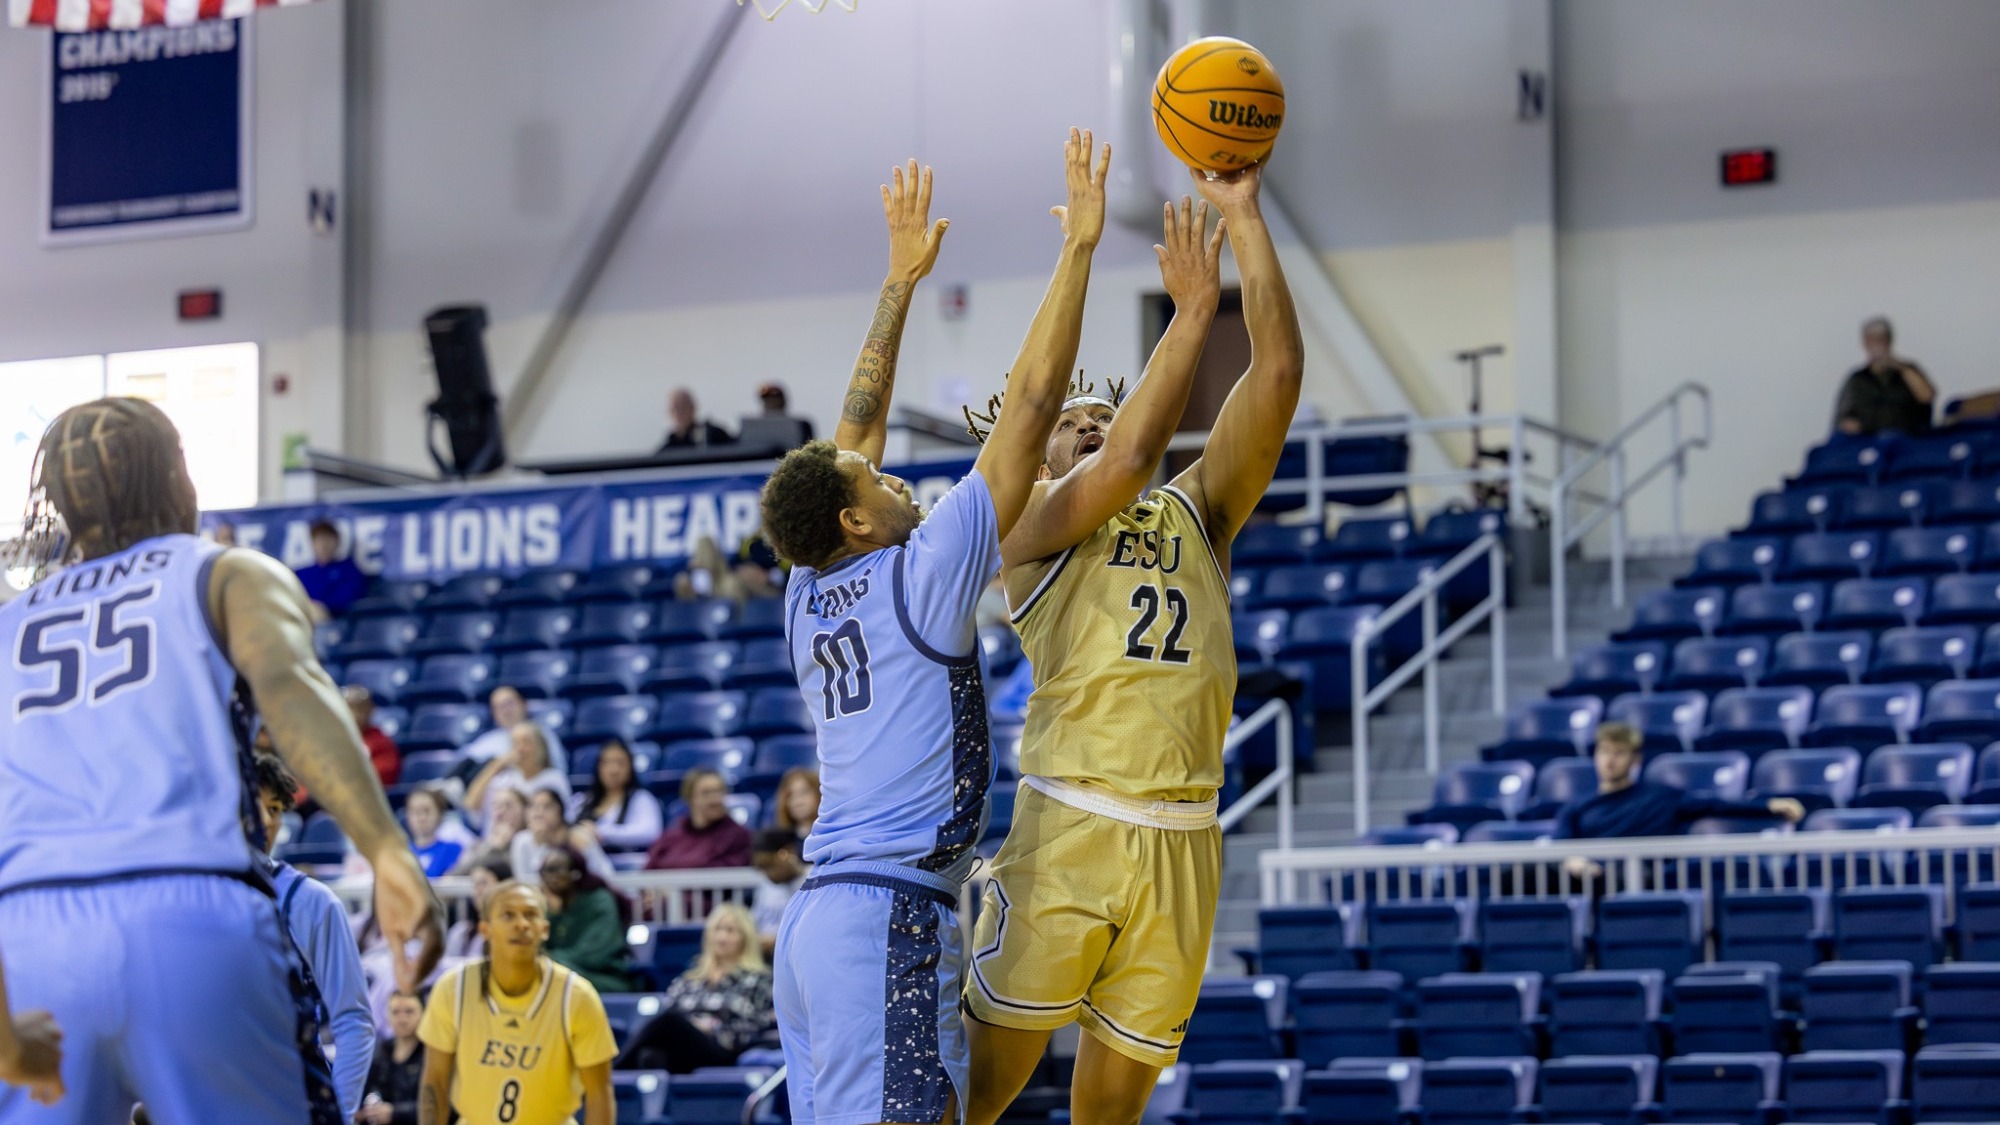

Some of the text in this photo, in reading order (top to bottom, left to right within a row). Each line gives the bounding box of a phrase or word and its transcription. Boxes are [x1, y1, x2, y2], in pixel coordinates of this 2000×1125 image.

[1209, 99, 1281, 129] Wilson
[402, 504, 560, 574] LIONS
[1106, 529, 1183, 575] ESU
[27, 550, 174, 606] LIONS
[14, 580, 162, 723] 55
[1124, 583, 1193, 666] 22
[811, 616, 874, 722] 10
[480, 1039, 542, 1071] ESU
[498, 1079, 520, 1123] 8
